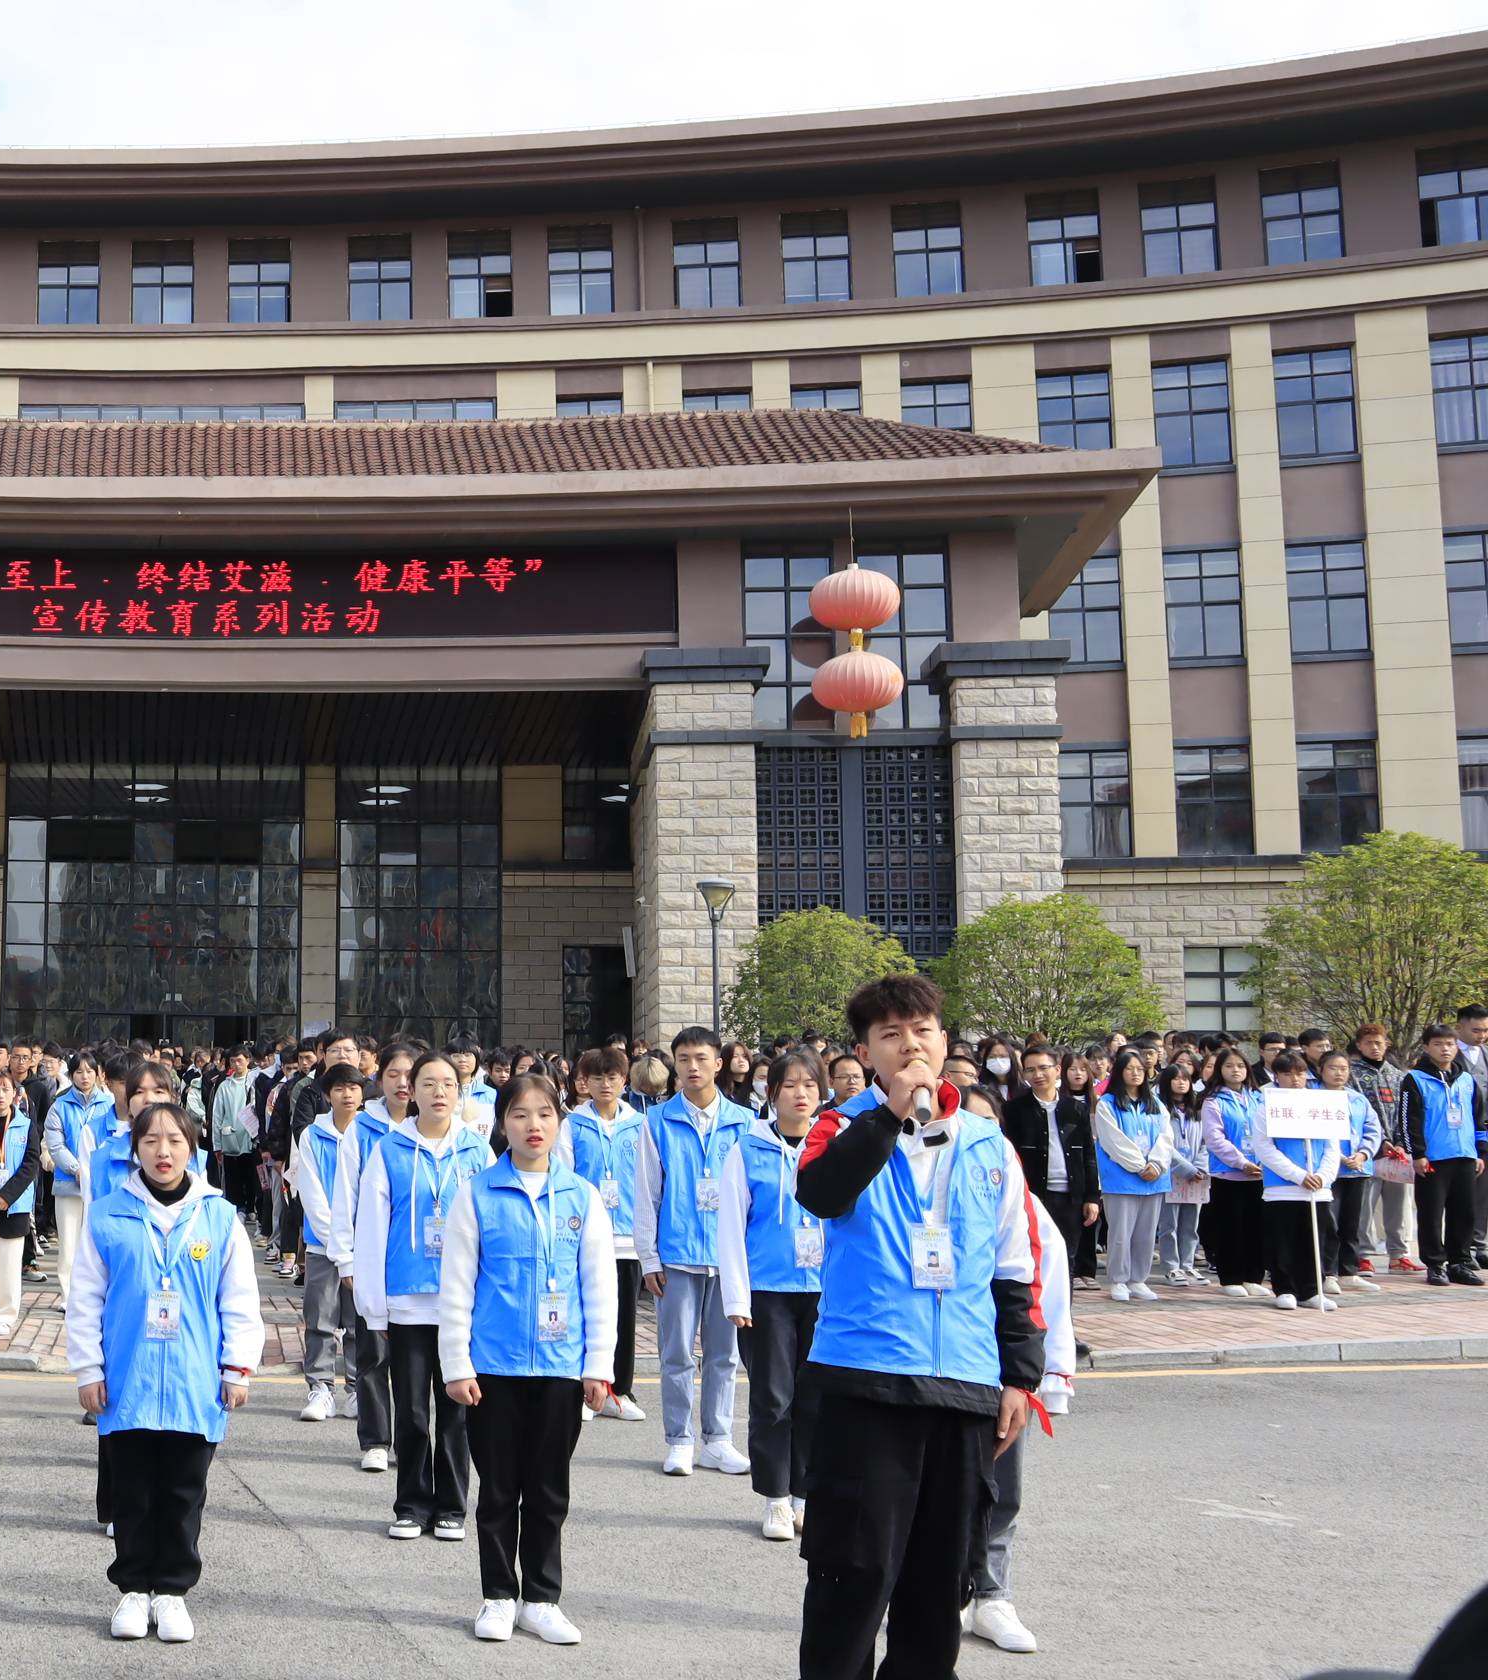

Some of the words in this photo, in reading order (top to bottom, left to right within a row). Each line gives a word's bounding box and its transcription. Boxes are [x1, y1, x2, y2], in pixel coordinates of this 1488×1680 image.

[31, 599, 381, 637] 宣传教育系列活动
